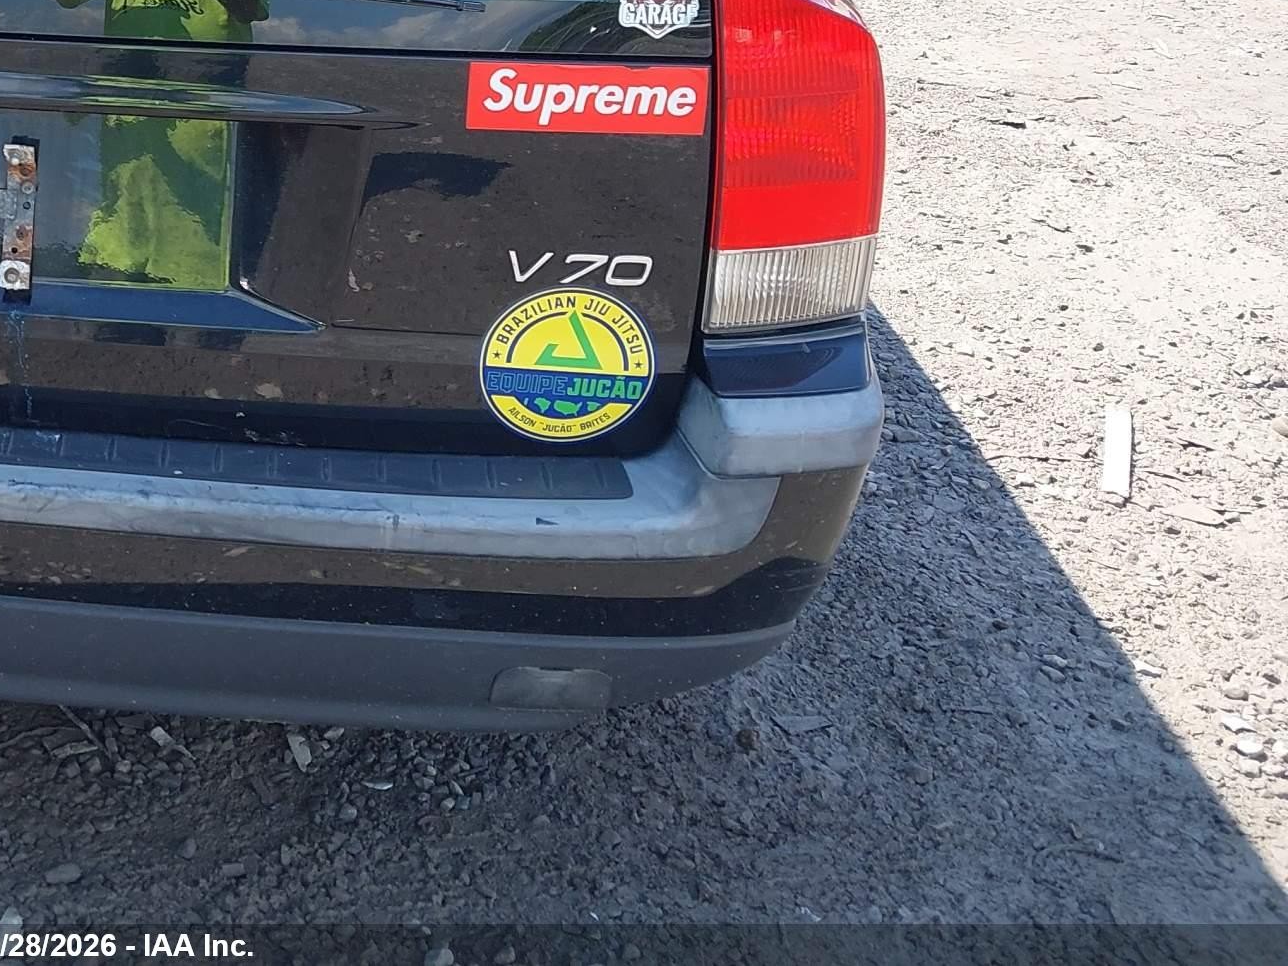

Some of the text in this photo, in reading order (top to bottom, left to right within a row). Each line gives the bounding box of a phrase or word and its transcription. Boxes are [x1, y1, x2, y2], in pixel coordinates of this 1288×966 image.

[483, 67, 698, 126] Supreme
[496, 296, 644, 355] BRAZILIAN JIU JITSU
[508, 406, 537, 428] AILSON
[580, 412, 611, 431] BRITES
